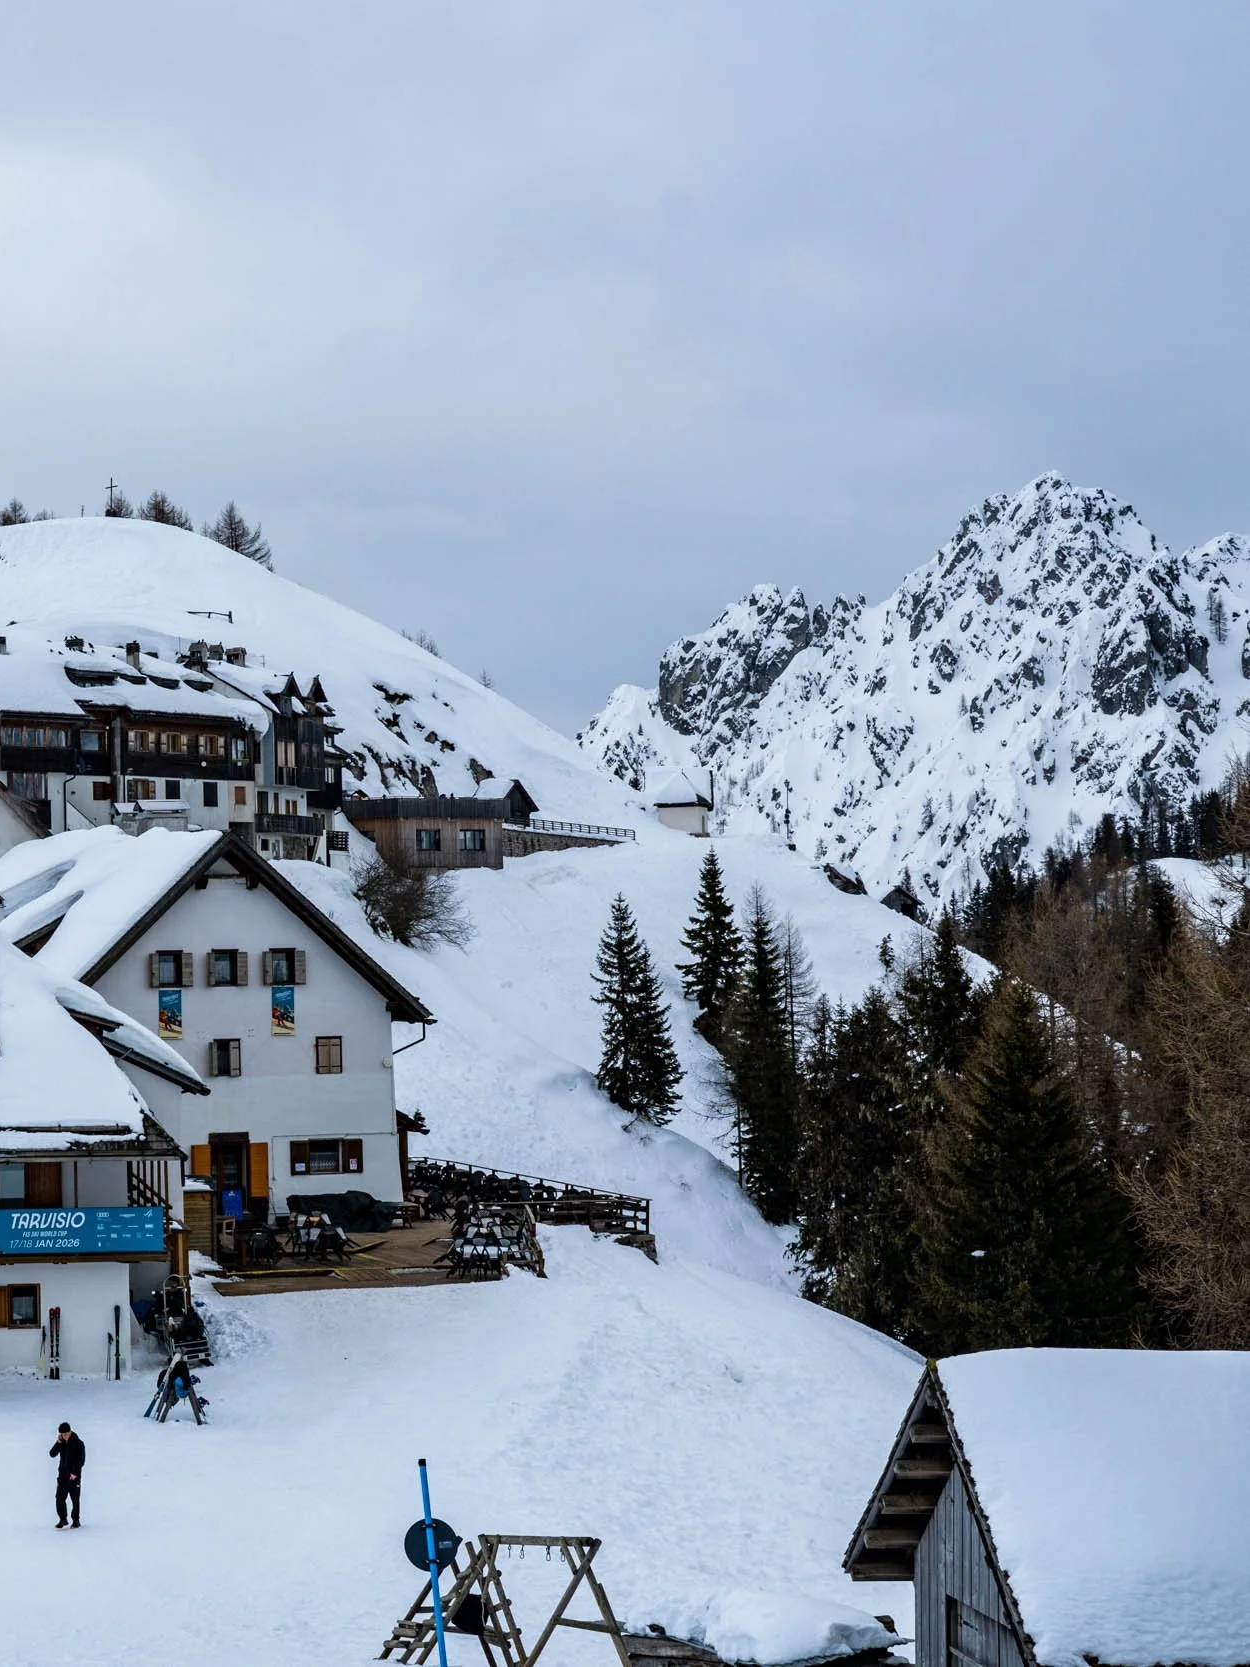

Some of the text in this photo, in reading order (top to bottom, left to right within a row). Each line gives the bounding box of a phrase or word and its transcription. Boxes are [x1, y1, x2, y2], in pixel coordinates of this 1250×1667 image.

[11, 1212, 85, 1229] TARVISIO
[10, 1239, 80, 1248] 17/18 JAN 2026
